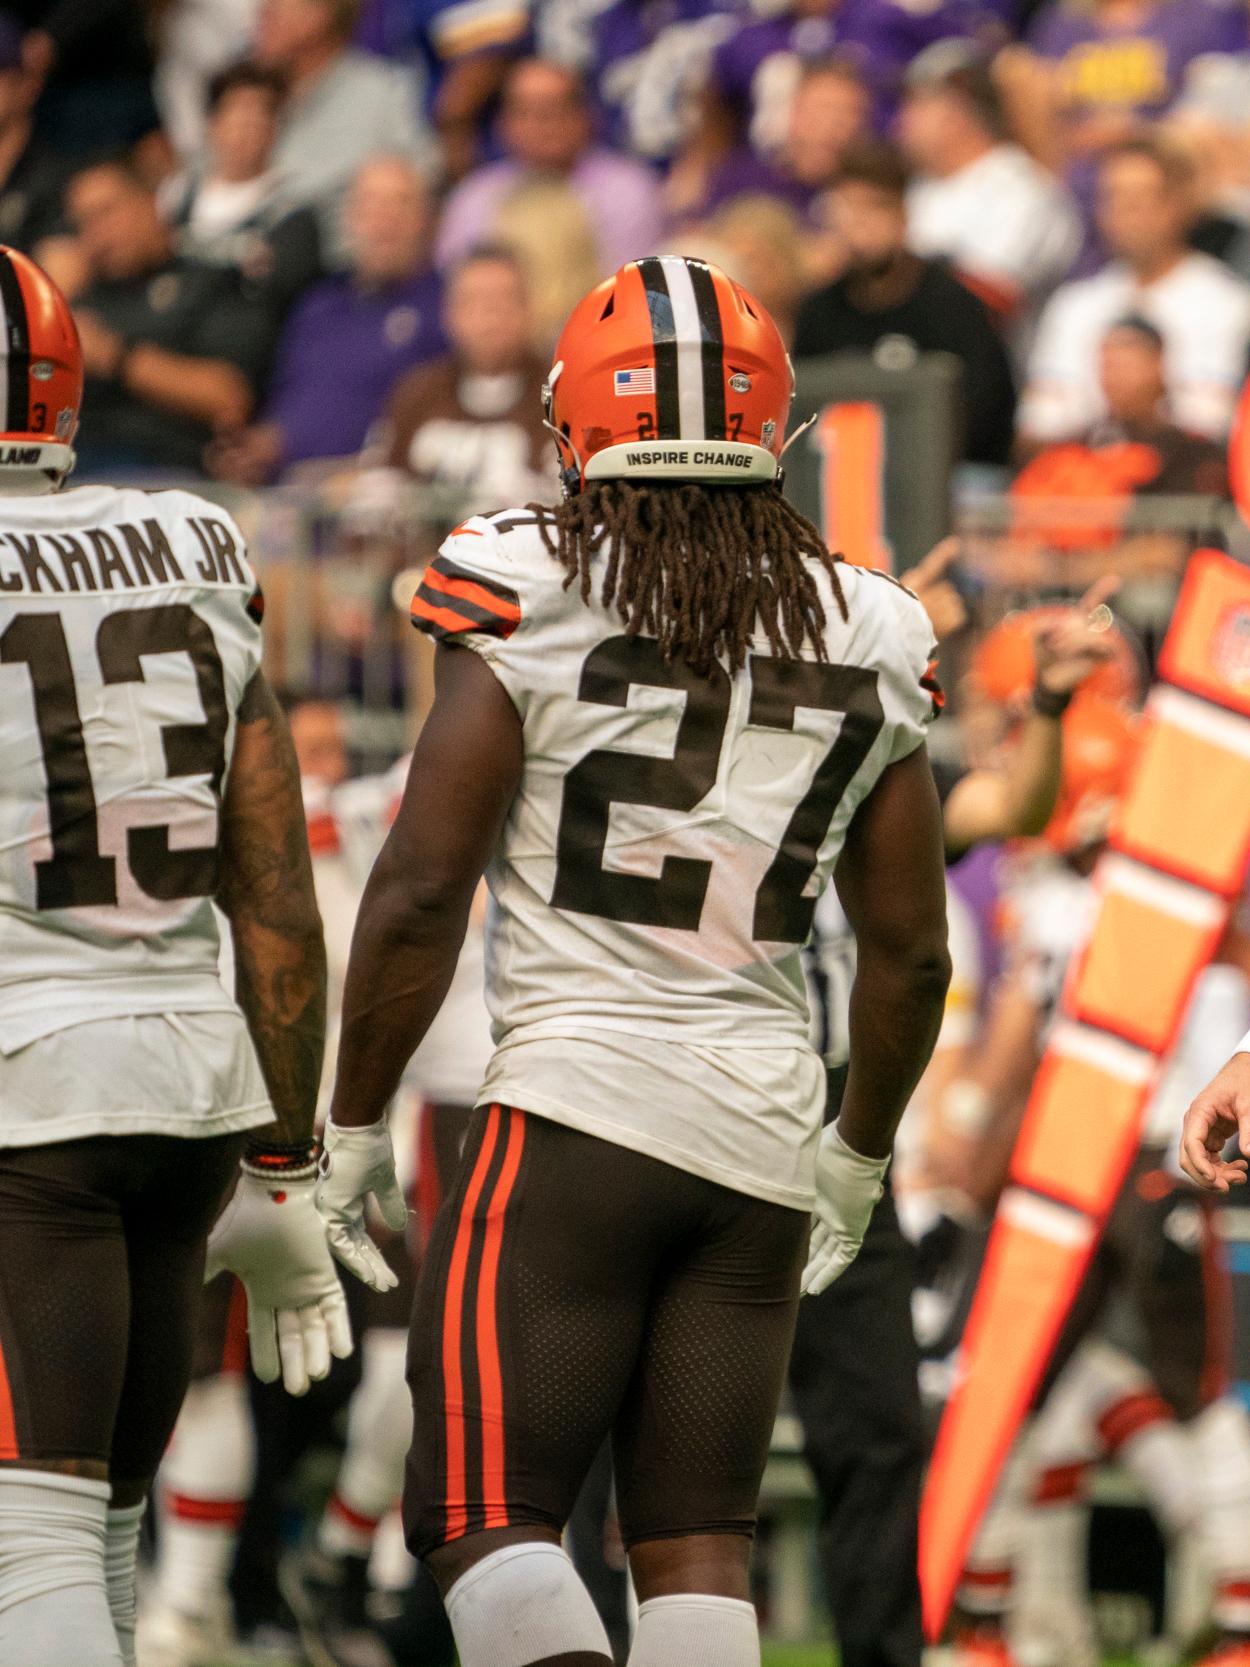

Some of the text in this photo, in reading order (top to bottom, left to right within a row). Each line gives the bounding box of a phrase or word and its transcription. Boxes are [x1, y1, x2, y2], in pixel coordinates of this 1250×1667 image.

[31, 401, 47, 434] 3
[626, 451, 753, 469] INSPIRE CHANGE
[186, 516, 247, 585] JR
[0, 603, 227, 911] 13
[549, 634, 886, 943] 27
